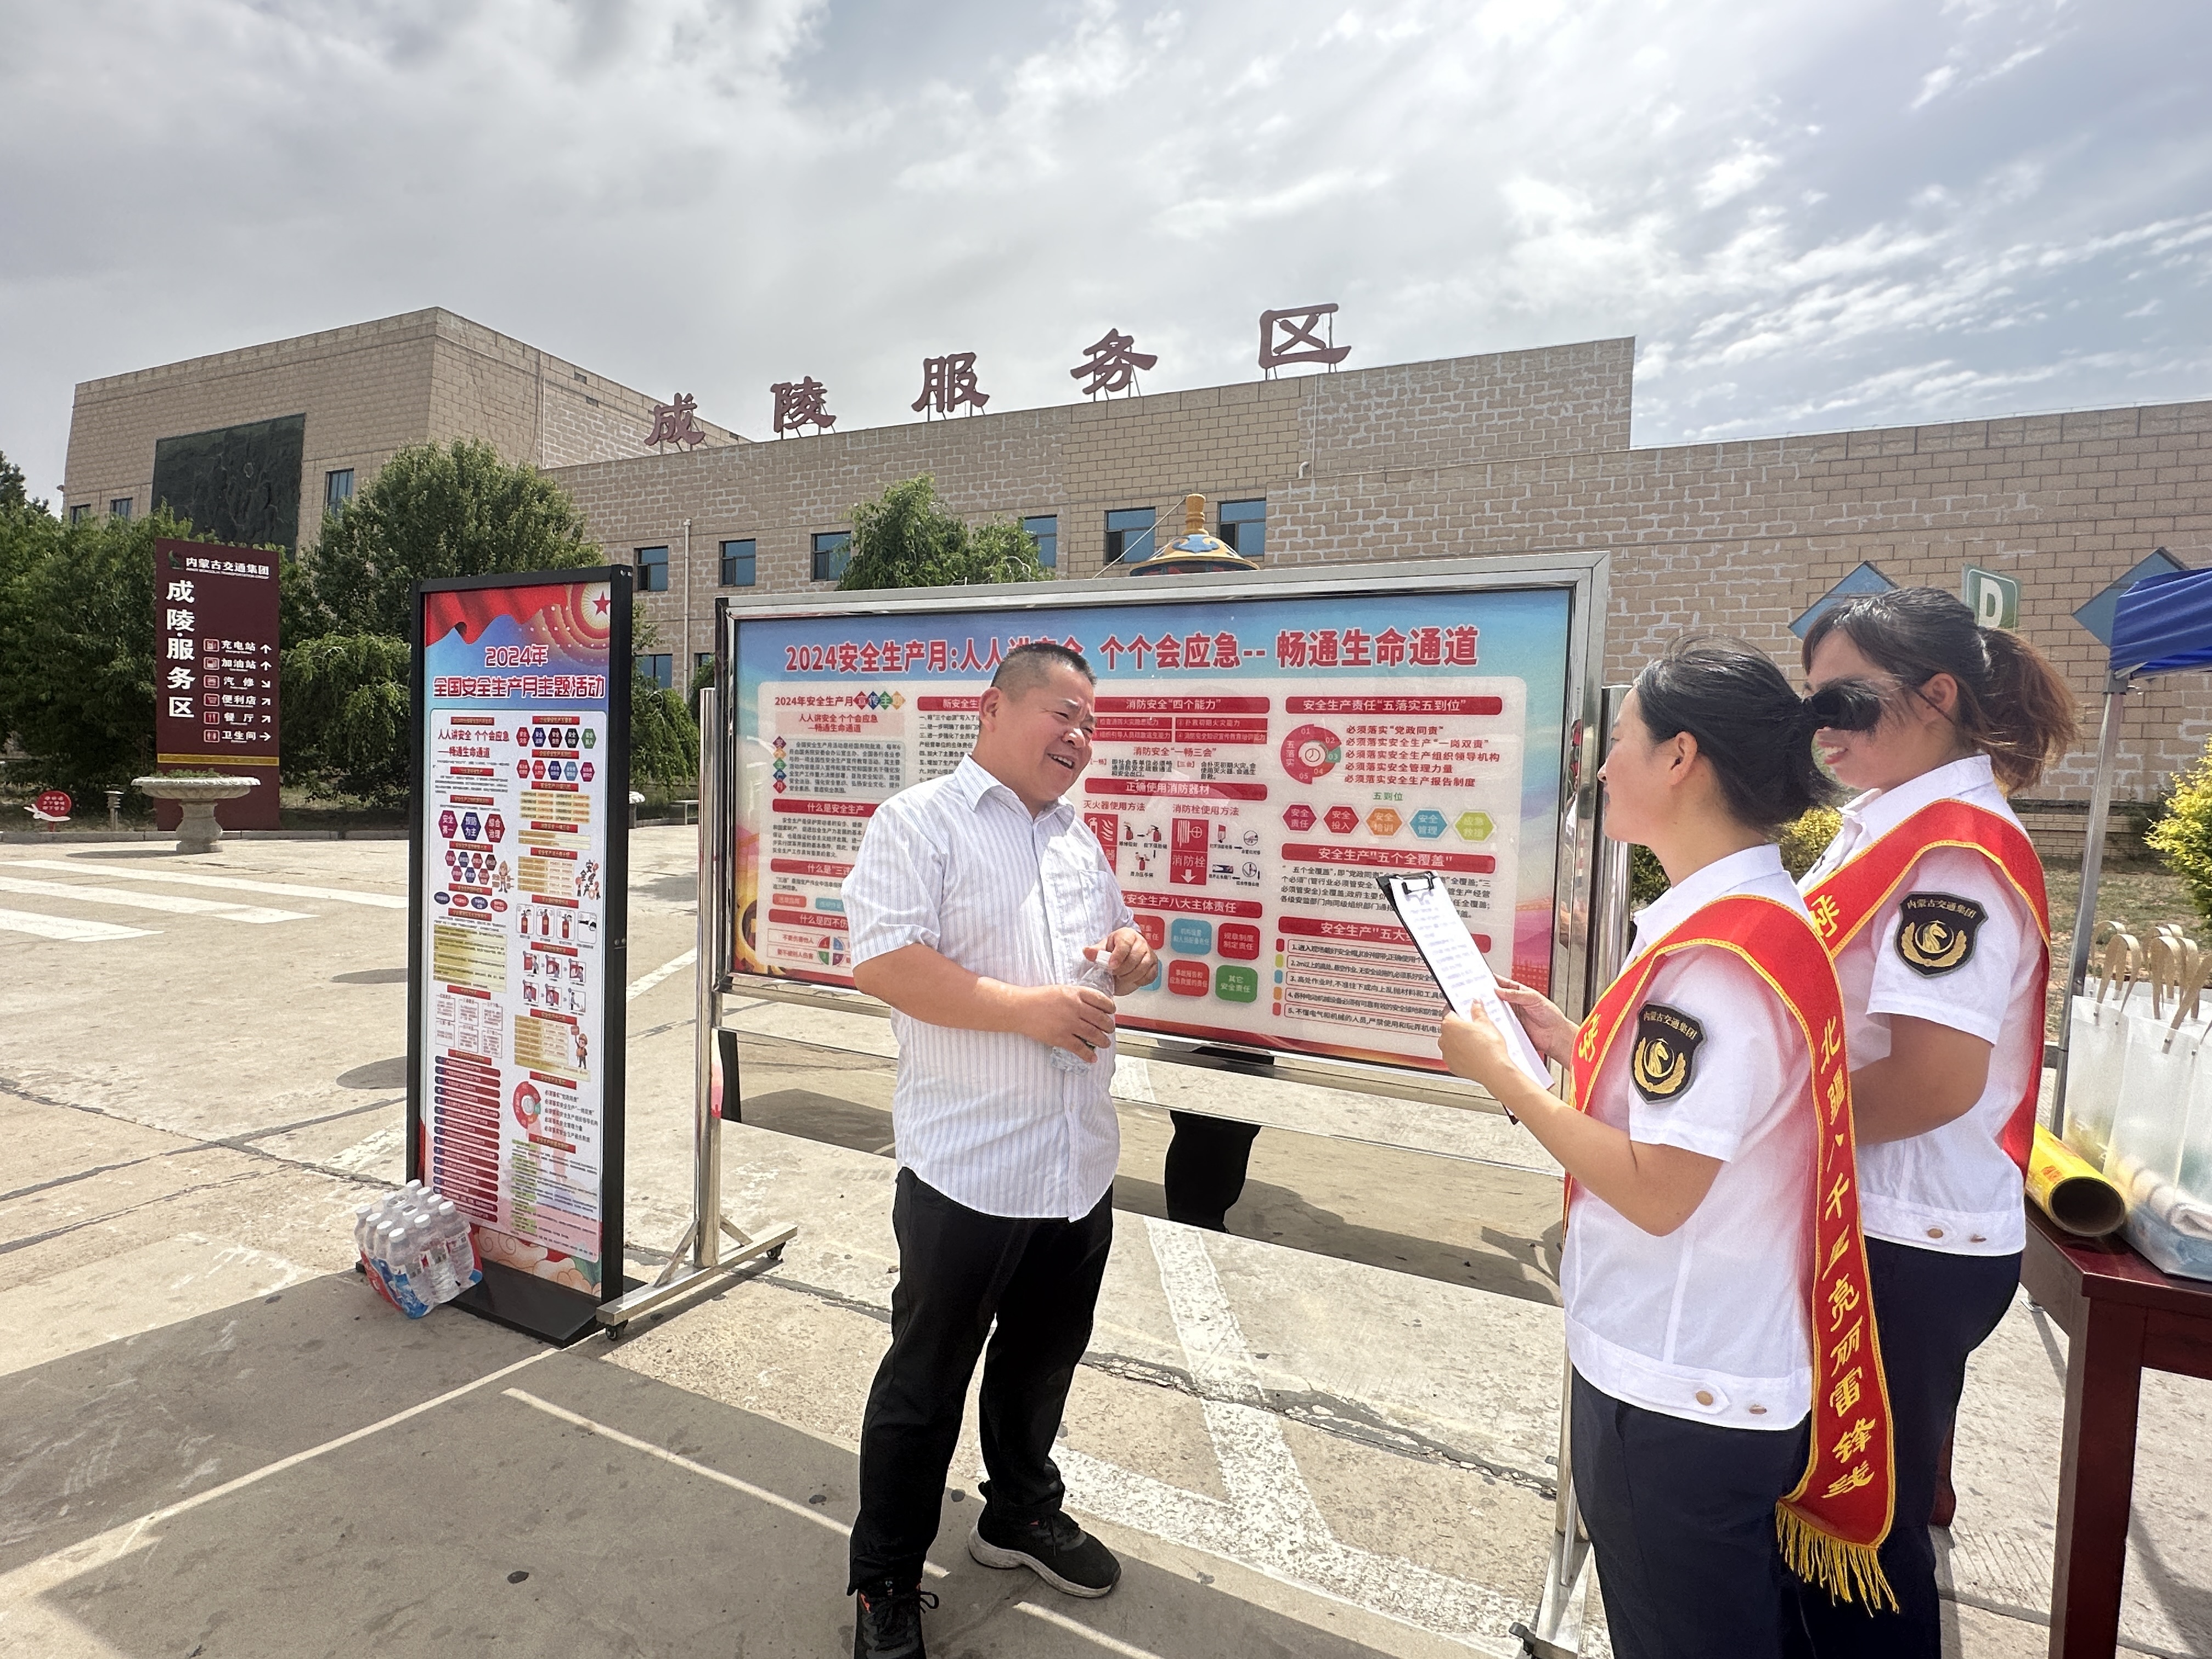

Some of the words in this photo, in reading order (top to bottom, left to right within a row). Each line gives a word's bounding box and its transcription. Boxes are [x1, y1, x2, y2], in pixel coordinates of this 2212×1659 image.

[644, 303, 1351, 445] 成陵服务区
[185, 557, 269, 575] 内蒙古交通集团
[1978, 577, 2003, 628] D
[221, 640, 256, 651] 充电站
[785, 635, 1085, 674] 2024安全生产月:人人
[1276, 624, 1480, 669] 畅通生命通道
[485, 644, 549, 668] 2024年
[221, 658, 256, 669] 加油站
[223, 676, 255, 687] 汽修
[433, 675, 605, 698] 全国安全生产月主题活动
[222, 695, 256, 706] 便利店
[943, 698, 979, 709] 新安全生
[1126, 698, 1221, 710] 消防安全“四个能力”
[1303, 698, 1466, 712] 安全生产责任“五落实五到位”
[224, 712, 254, 723] 餐厅
[799, 714, 837, 723] 人人讲安全
[838, 714, 878, 723] 个个会应急
[1346, 725, 1444, 735] 必须落实“党政同责”
[221, 731, 256, 741] 卫生间
[1345, 737, 1489, 749] 必须落实安全生产“一岗双责”
[1133, 746, 1216, 757] 消防安全“一畅三会”
[1286, 741, 1295, 767] 五落实
[1345, 750, 1500, 762] 必须落实安全生产组织领导机构
[1345, 762, 1453, 774] 必须落实安全管理力量
[1344, 774, 1476, 787] 必须落实安全生产报告制度
[1126, 782, 1210, 795] 正确使用消防器材
[1373, 792, 1403, 802] 五到位
[807, 803, 865, 814] 什么是安全生产
[1083, 800, 1146, 812] 灭火器使用方法
[1172, 803, 1239, 816] 消防栓使用方法
[1290, 808, 1308, 817] 安全
[1331, 810, 1350, 820] 安全
[1374, 812, 1394, 821] 安全
[1418, 814, 1438, 823] 安全
[1290, 819, 1309, 828] 责任
[1331, 821, 1350, 831] 投入
[1373, 822, 1394, 833] 培训
[1418, 825, 1438, 835] 管理
[1172, 855, 1206, 868] 消防栓
[1907, 899, 1977, 919] 内蒙古交通集团
[1224, 933, 1254, 942] 规章制度
[1223, 941, 1254, 950] 制定责任
[1228, 975, 1244, 983] 其它
[1220, 982, 1251, 993] 安全责任
[1643, 1011, 1697, 1041] 内蒙古交通集团
